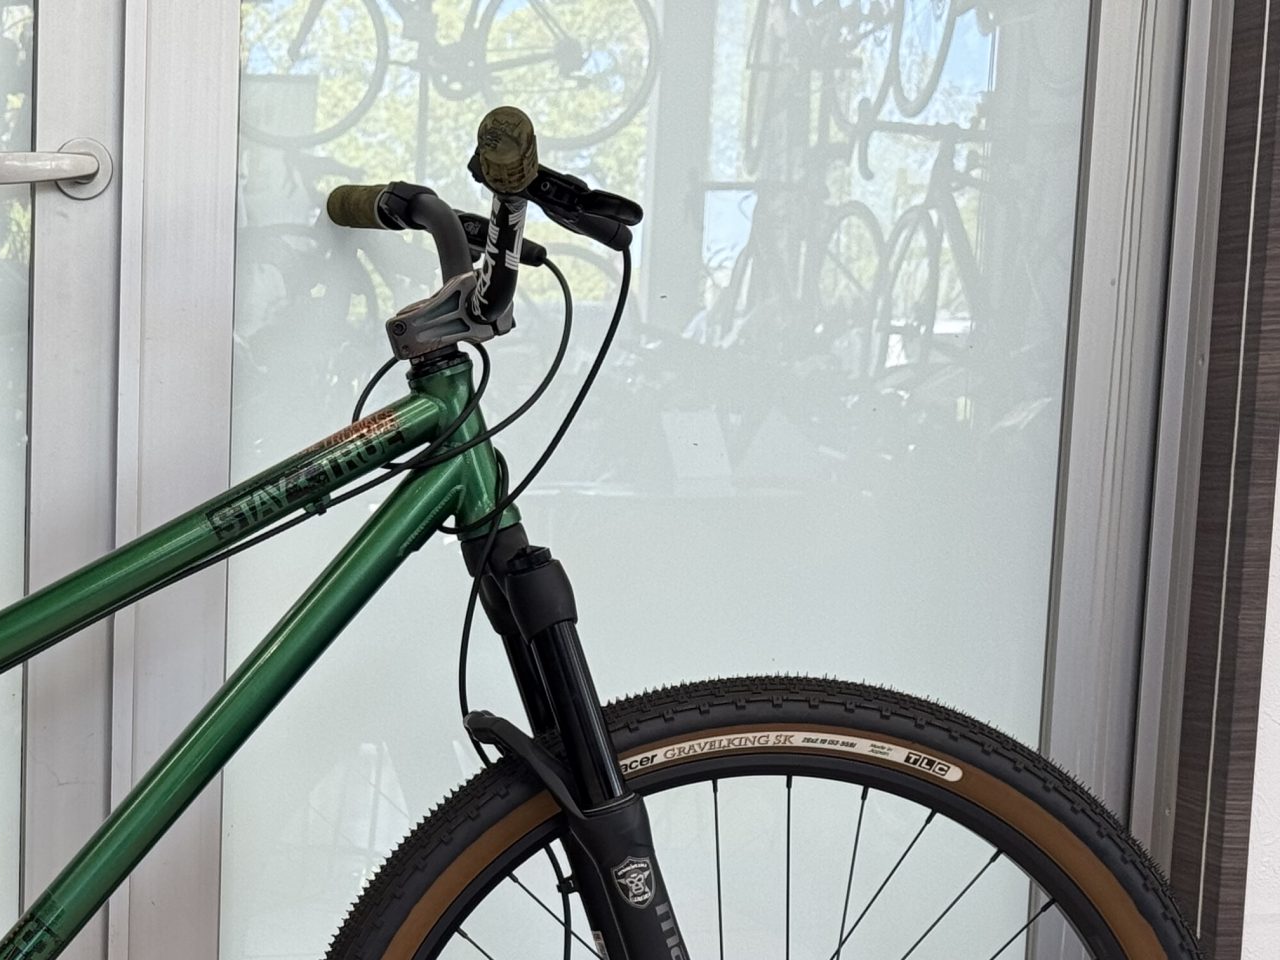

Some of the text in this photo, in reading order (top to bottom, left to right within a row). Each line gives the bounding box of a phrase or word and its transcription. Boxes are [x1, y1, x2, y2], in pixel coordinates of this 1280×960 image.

[663, 735, 771, 760] GRAVELKING
[773, 734, 795, 745] SK
[904, 752, 951, 777] TLC
